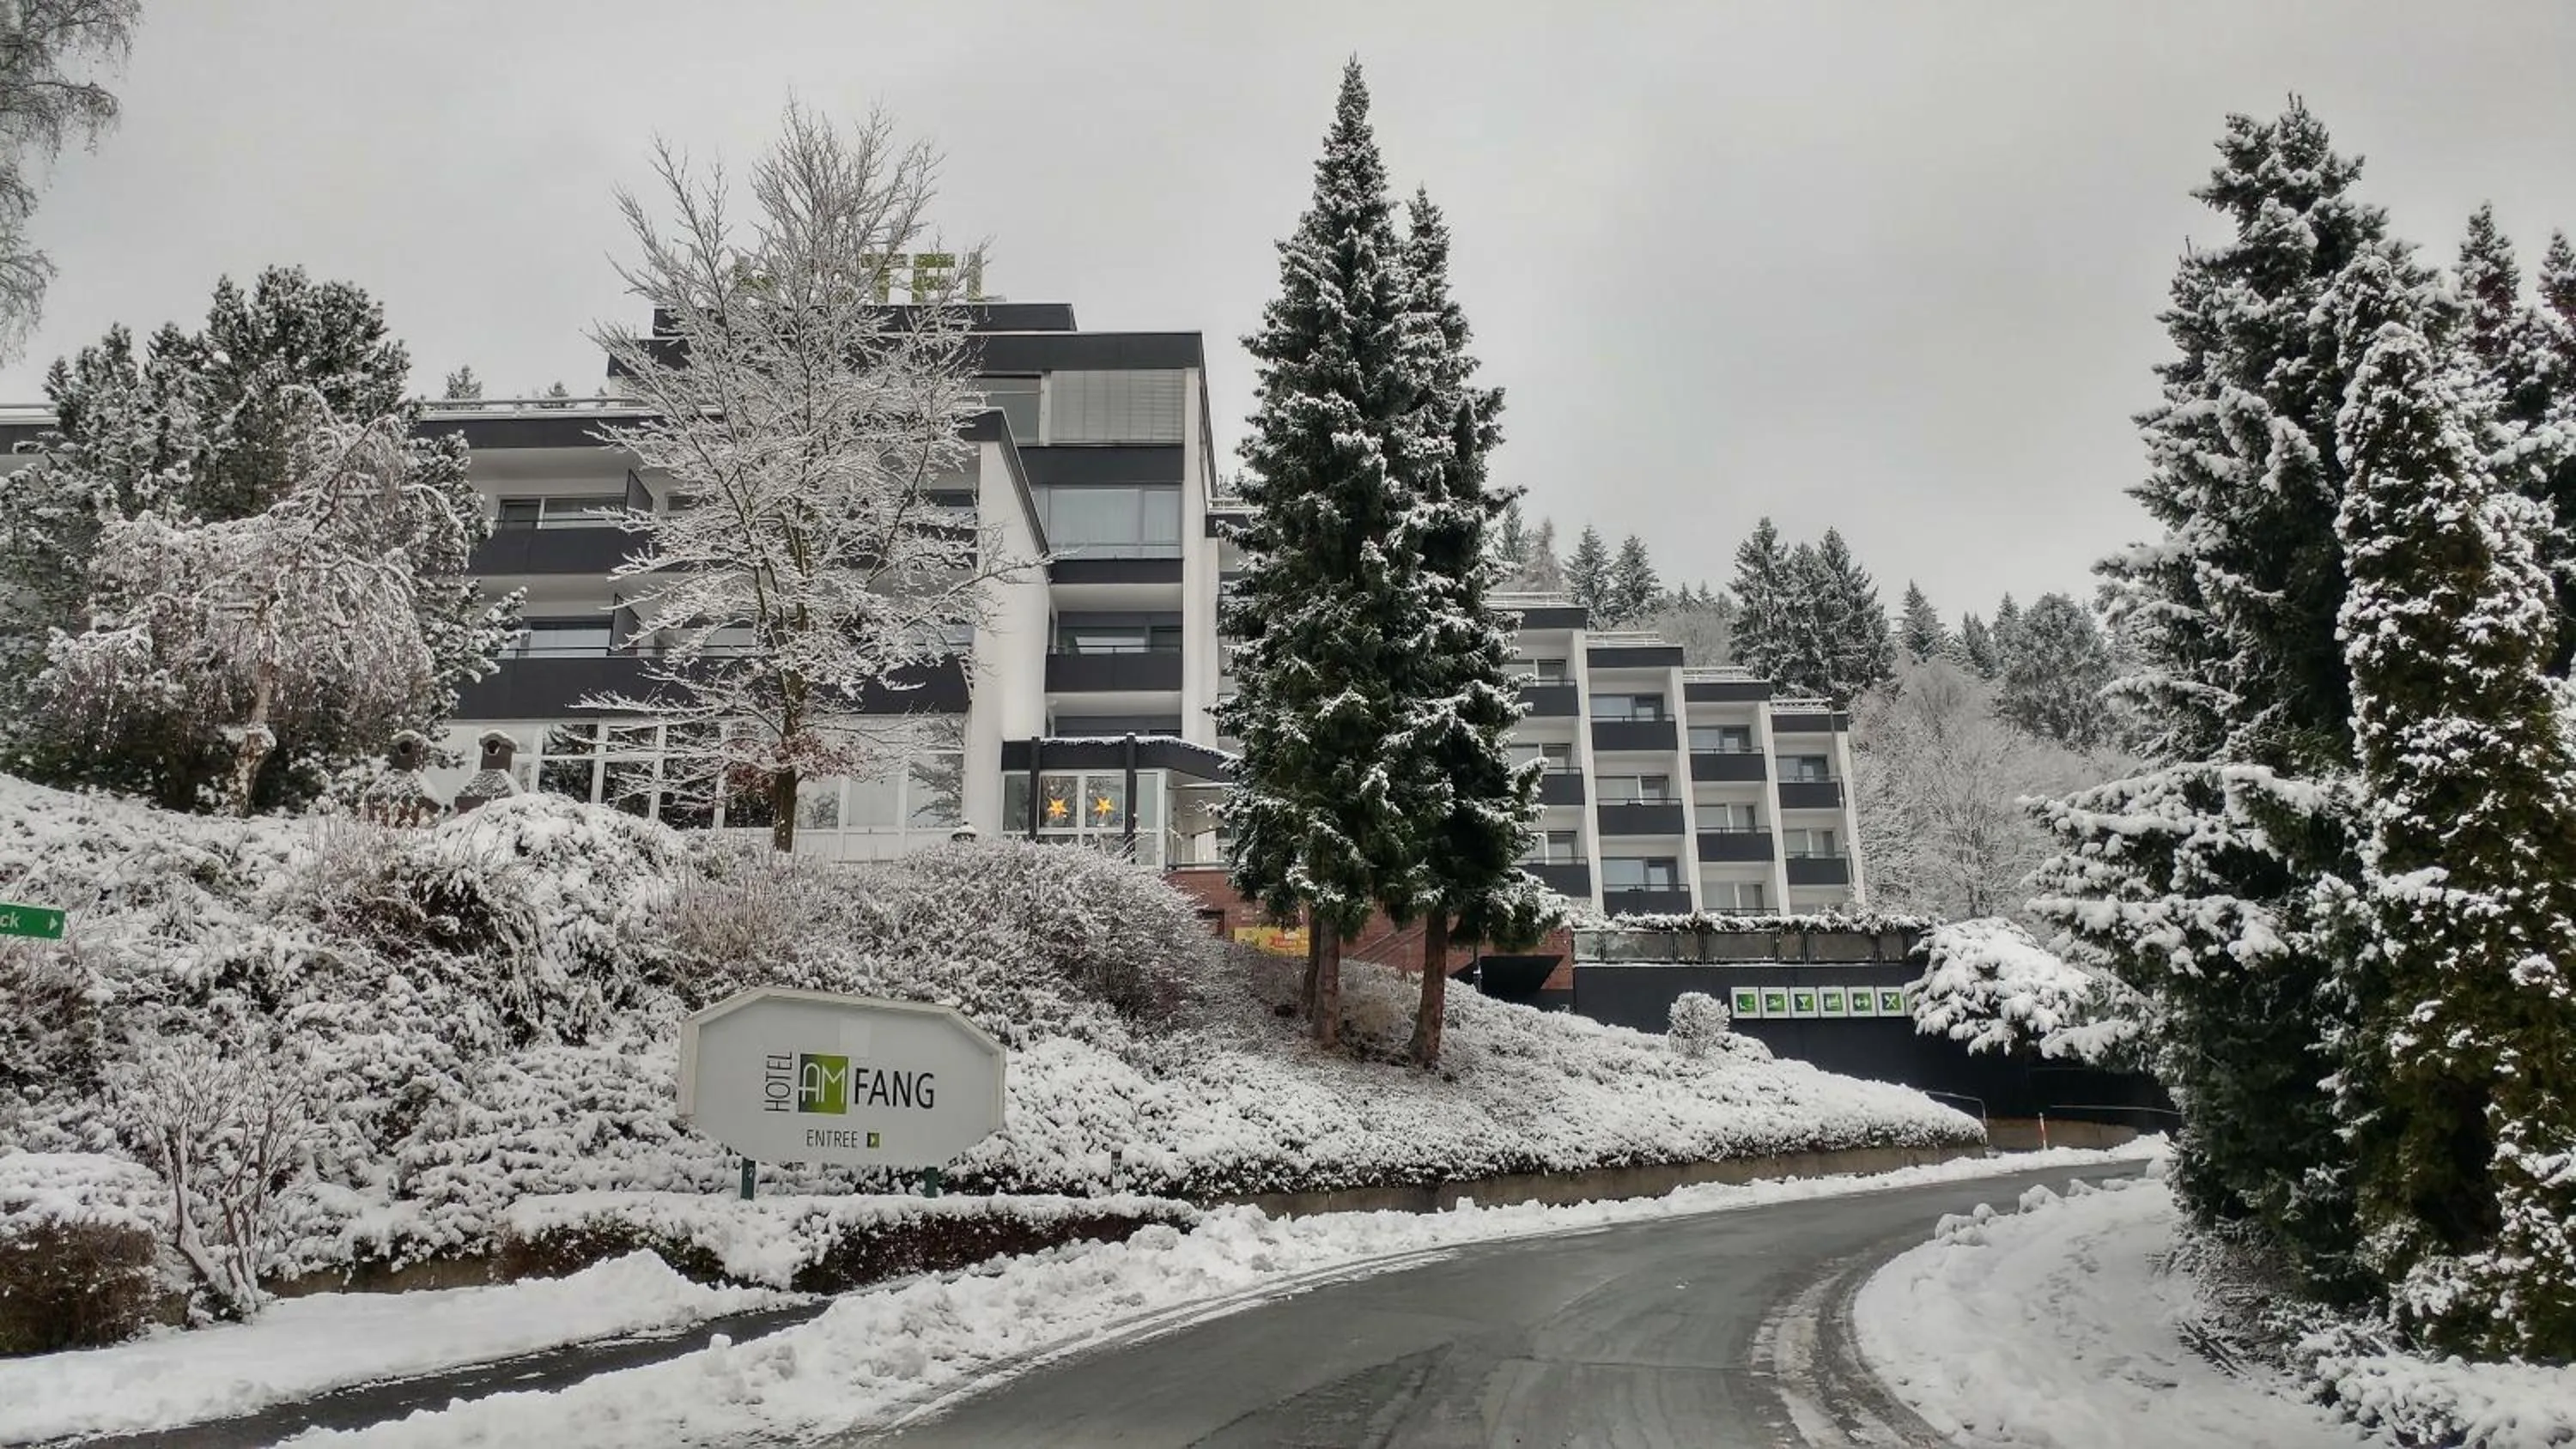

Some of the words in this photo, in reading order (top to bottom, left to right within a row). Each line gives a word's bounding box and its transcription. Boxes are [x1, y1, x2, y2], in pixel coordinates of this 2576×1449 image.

[736, 253, 1005, 302] TEL
[764, 1052, 792, 1112] HOTEL
[799, 1063, 845, 1103] AM
[854, 1068, 934, 1109] FANG
[806, 1129, 858, 1148] ENTREE
